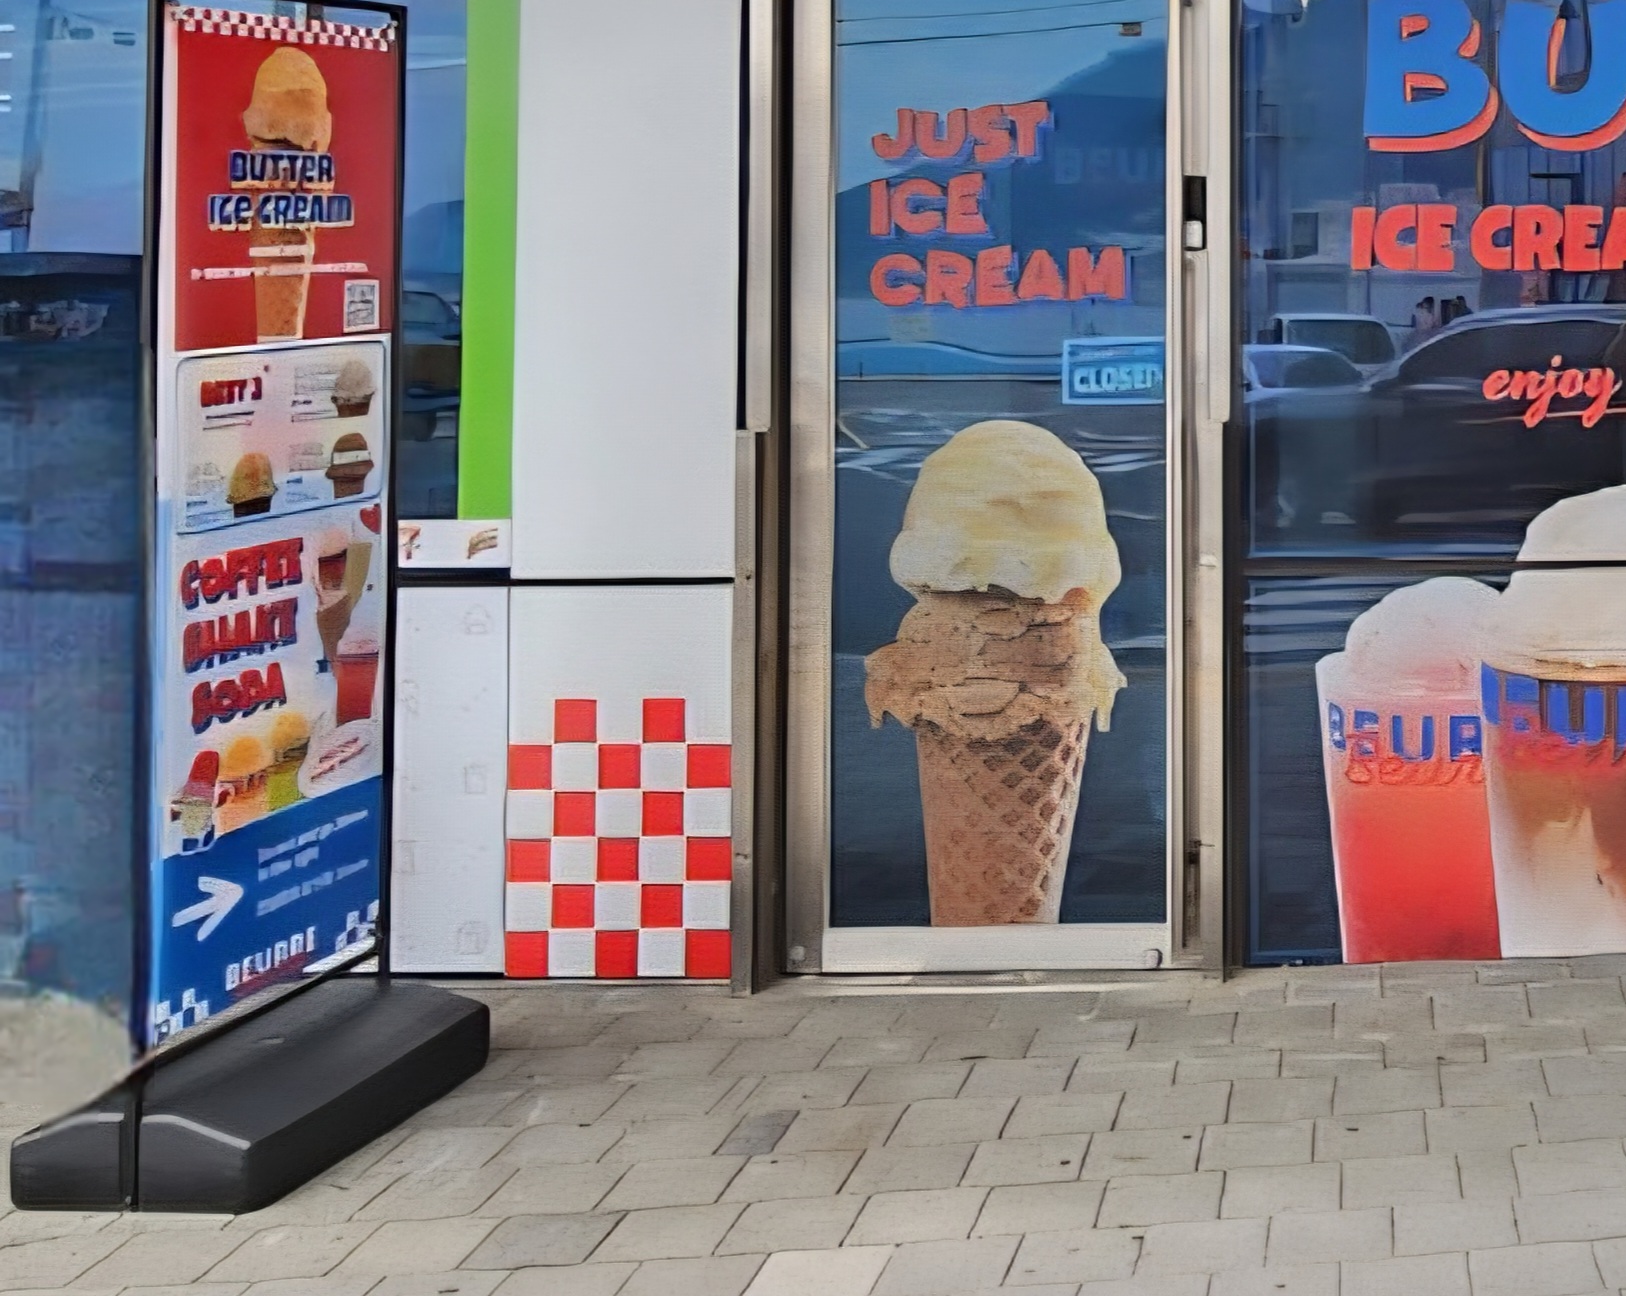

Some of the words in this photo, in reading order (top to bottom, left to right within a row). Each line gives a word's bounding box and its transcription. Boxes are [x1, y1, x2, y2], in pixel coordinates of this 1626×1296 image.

[870, 99, 1053, 164] JUST
[868, 171, 990, 237] ICE
[1350, 204, 1457, 272] ICE
[869, 244, 1130, 309] CREAM
[1482, 354, 1621, 428] enjoy
